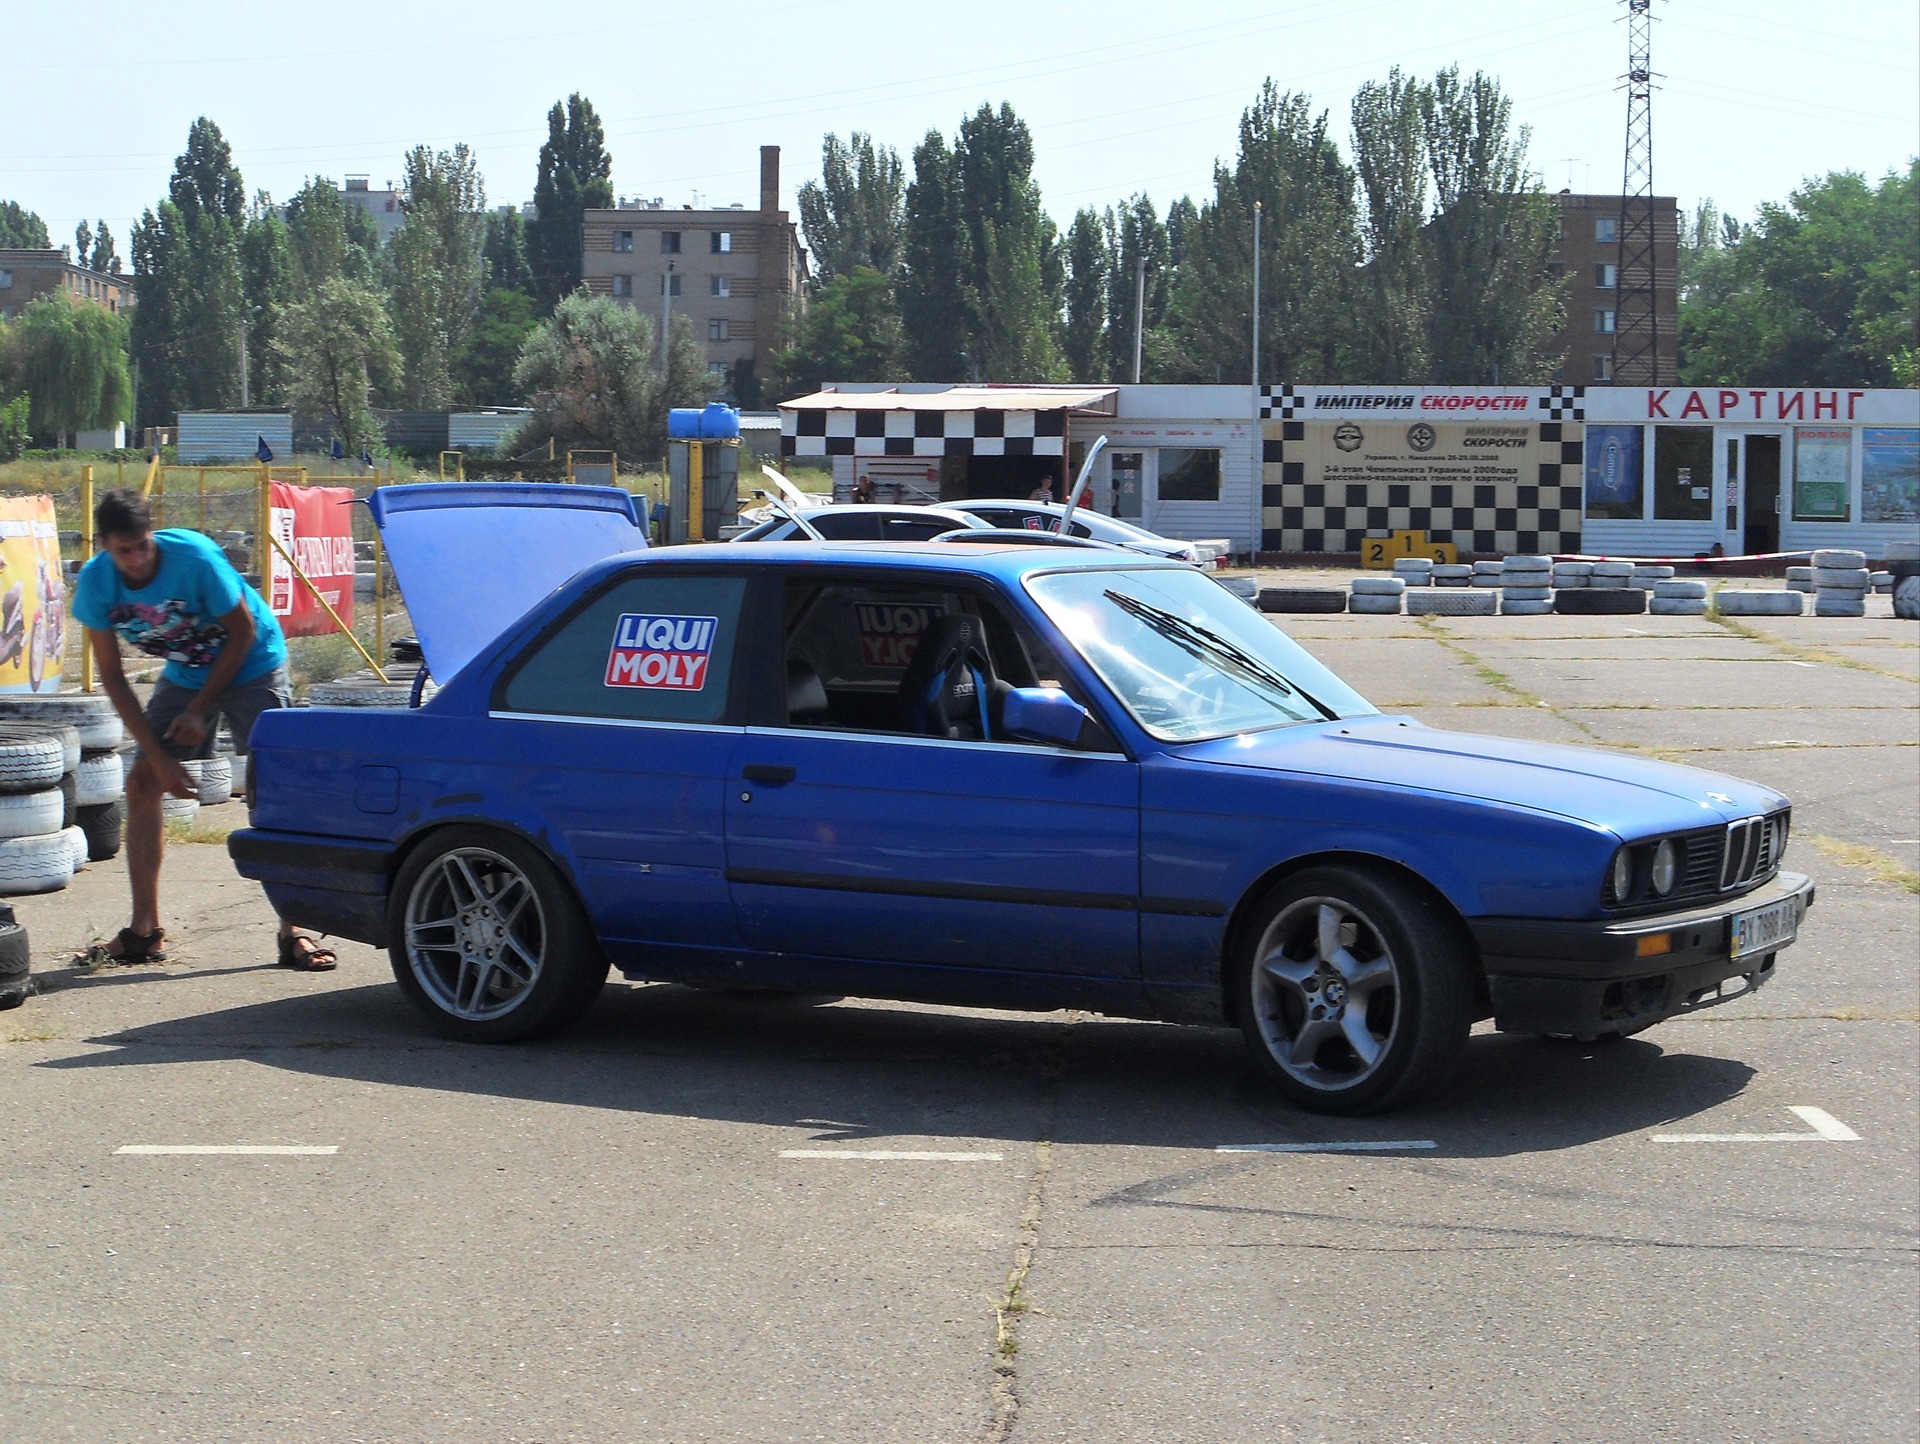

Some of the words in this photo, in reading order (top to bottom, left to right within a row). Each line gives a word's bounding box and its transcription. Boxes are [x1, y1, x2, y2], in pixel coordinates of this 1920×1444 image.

[1313, 394, 1415, 410] ИМПЕРИЯ
[1420, 395, 1529, 410] СКОРОСТИ
[1647, 390, 1864, 420] КАРТИНГ
[1462, 437, 1528, 448] СКОРОСТИ
[1796, 431, 1850, 439] HONDA
[1370, 543, 1384, 561] 2
[1404, 535, 1411, 553] 1
[1434, 549, 1446, 564] 3
[618, 618, 712, 651] LIQUI
[610, 652, 707, 686] MOLY
